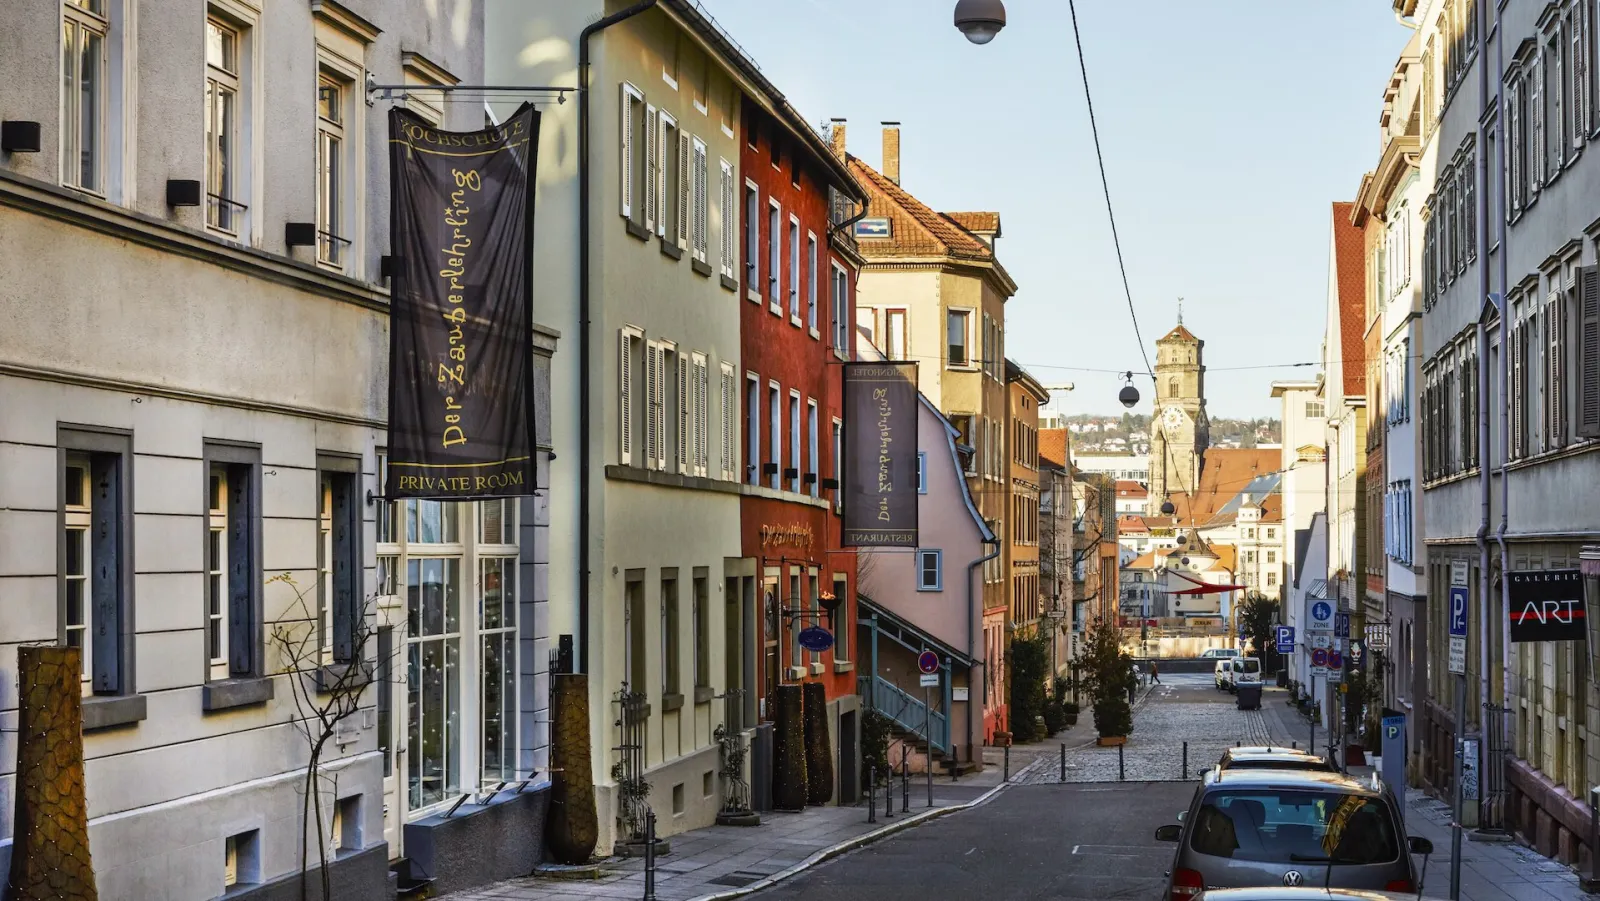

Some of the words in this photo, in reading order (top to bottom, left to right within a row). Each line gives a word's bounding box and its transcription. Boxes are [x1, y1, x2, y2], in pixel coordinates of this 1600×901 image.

[400, 119, 524, 147] KOCHSCHULE
[437, 168, 481, 386] Zauberlehrling
[443, 396, 467, 449] Der
[399, 475, 471, 491] PRIVATE
[475, 470, 524, 489] ROOM
[1514, 573, 1579, 582] GALERIE
[1453, 593, 1464, 629] P
[1518, 600, 1579, 625] ART
[1280, 629, 1289, 643] P
[1388, 726, 1397, 739] P
